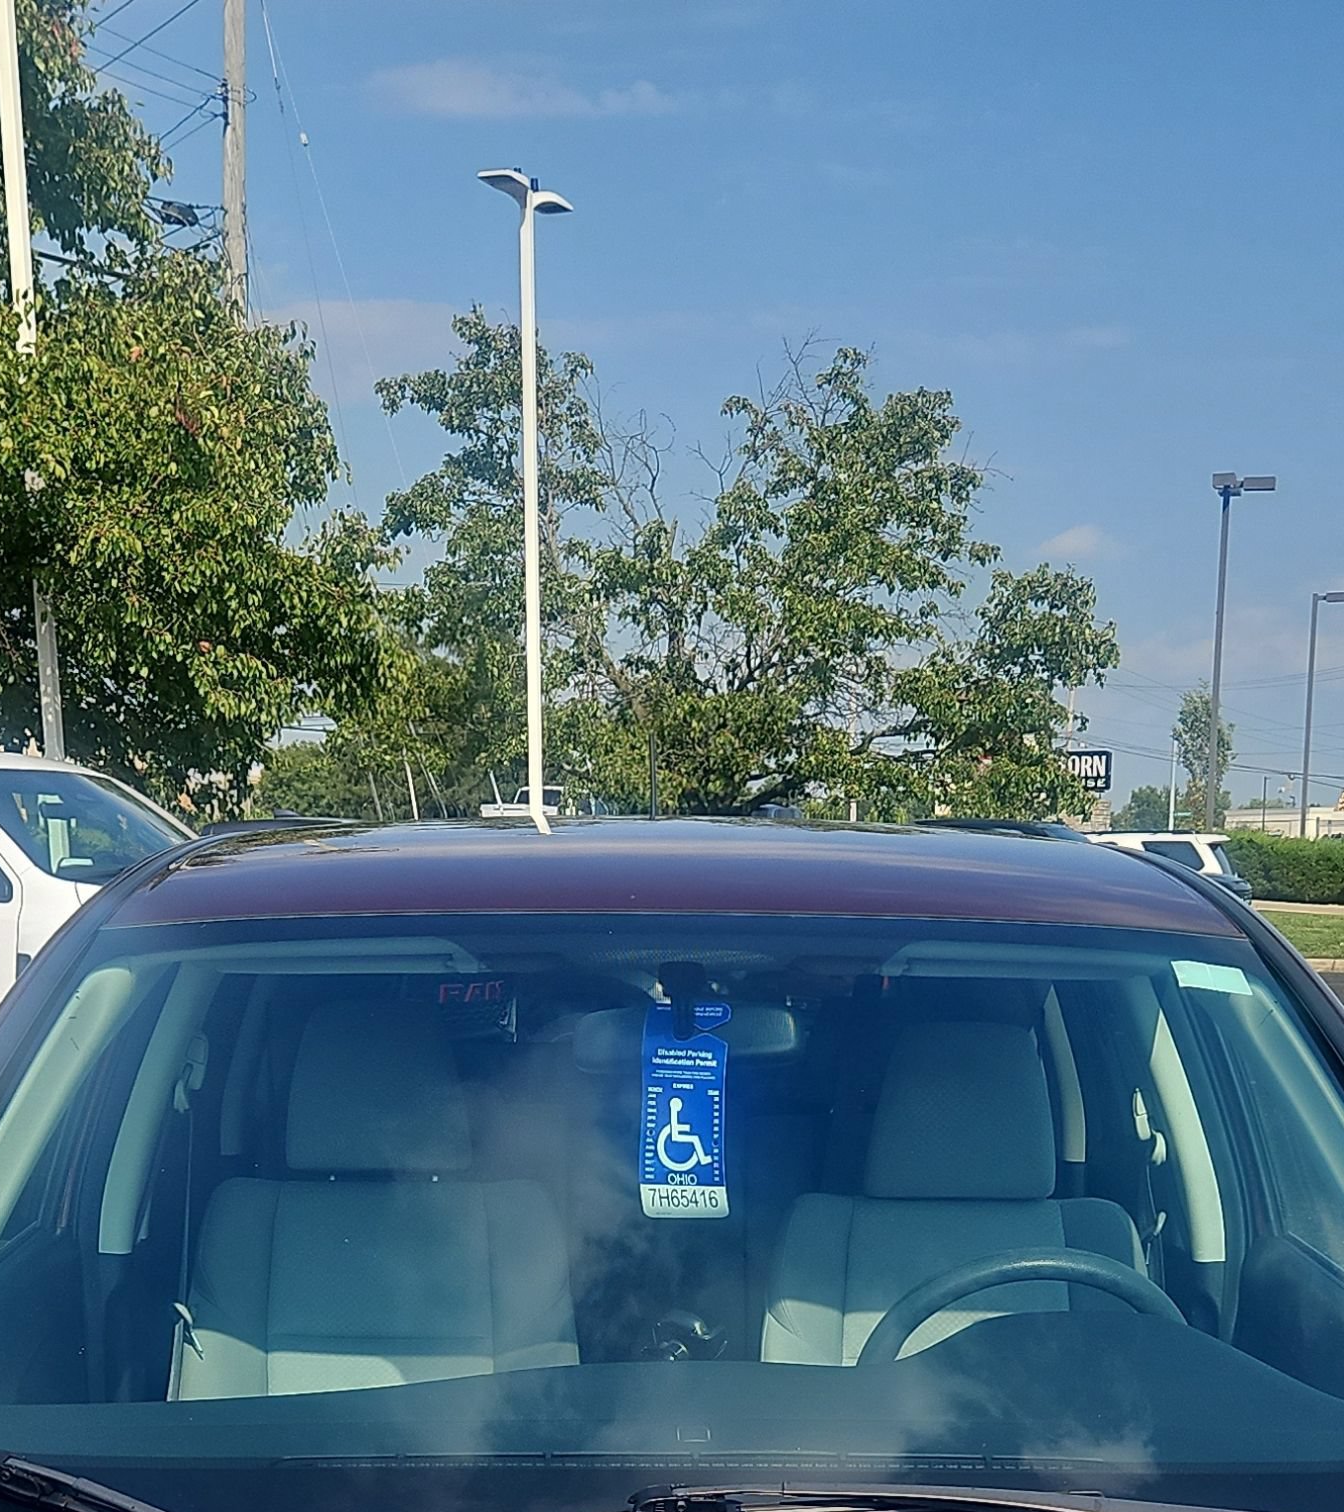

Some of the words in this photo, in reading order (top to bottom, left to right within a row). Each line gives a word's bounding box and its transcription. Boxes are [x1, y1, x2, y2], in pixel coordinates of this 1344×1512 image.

[1067, 755, 1107, 777] ORN
[667, 1172, 698, 1186] OHIO
[648, 1188, 719, 1209] 7H65416
